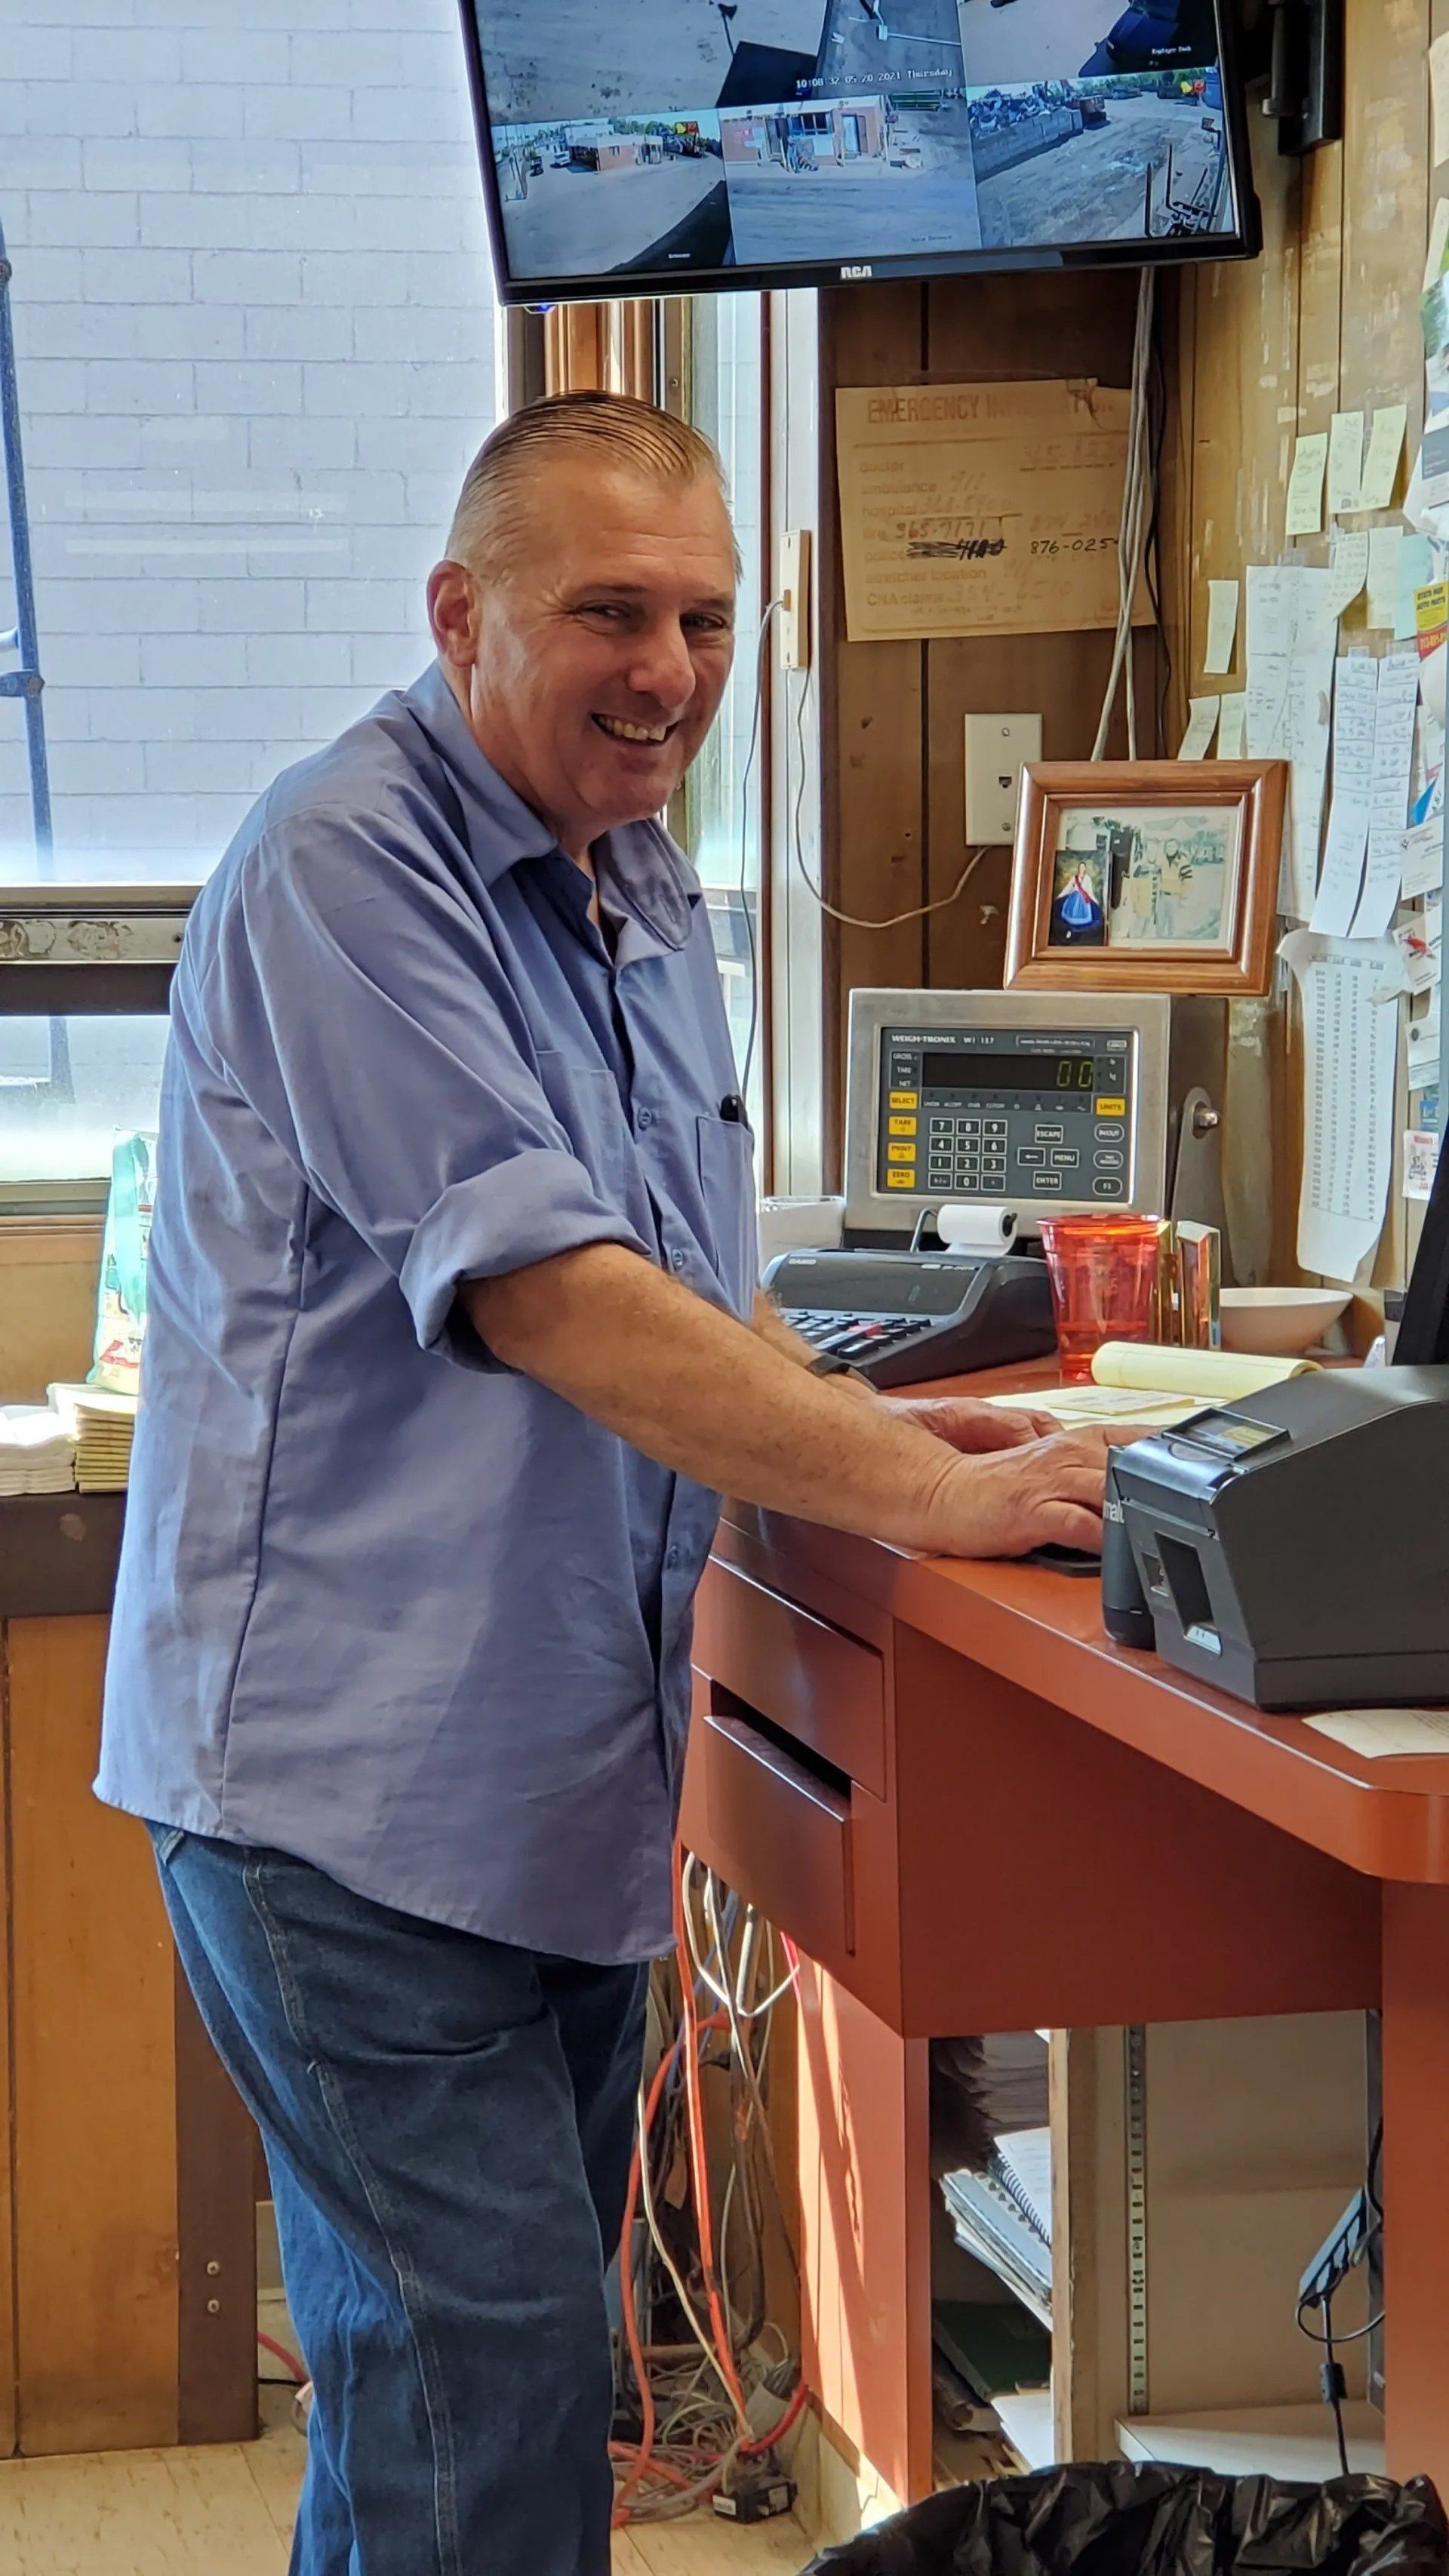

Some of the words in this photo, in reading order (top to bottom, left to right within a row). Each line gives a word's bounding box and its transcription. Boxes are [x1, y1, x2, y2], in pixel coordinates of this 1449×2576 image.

[907, 69, 952, 79] Thursday
[840, 266, 872, 279] RCA
[866, 394, 980, 424] EMERGENCY
[939, 1122, 945, 1131] 7
[965, 1122, 971, 1132] 8
[992, 1123, 998, 1133] 9
[938, 1140, 944, 1149] 4
[964, 1141, 971, 1150] 5
[991, 1141, 998, 1151] 6
[964, 1159, 971, 1168] 2
[990, 1159, 996, 1169] 3
[963, 1177, 970, 1186] 0
